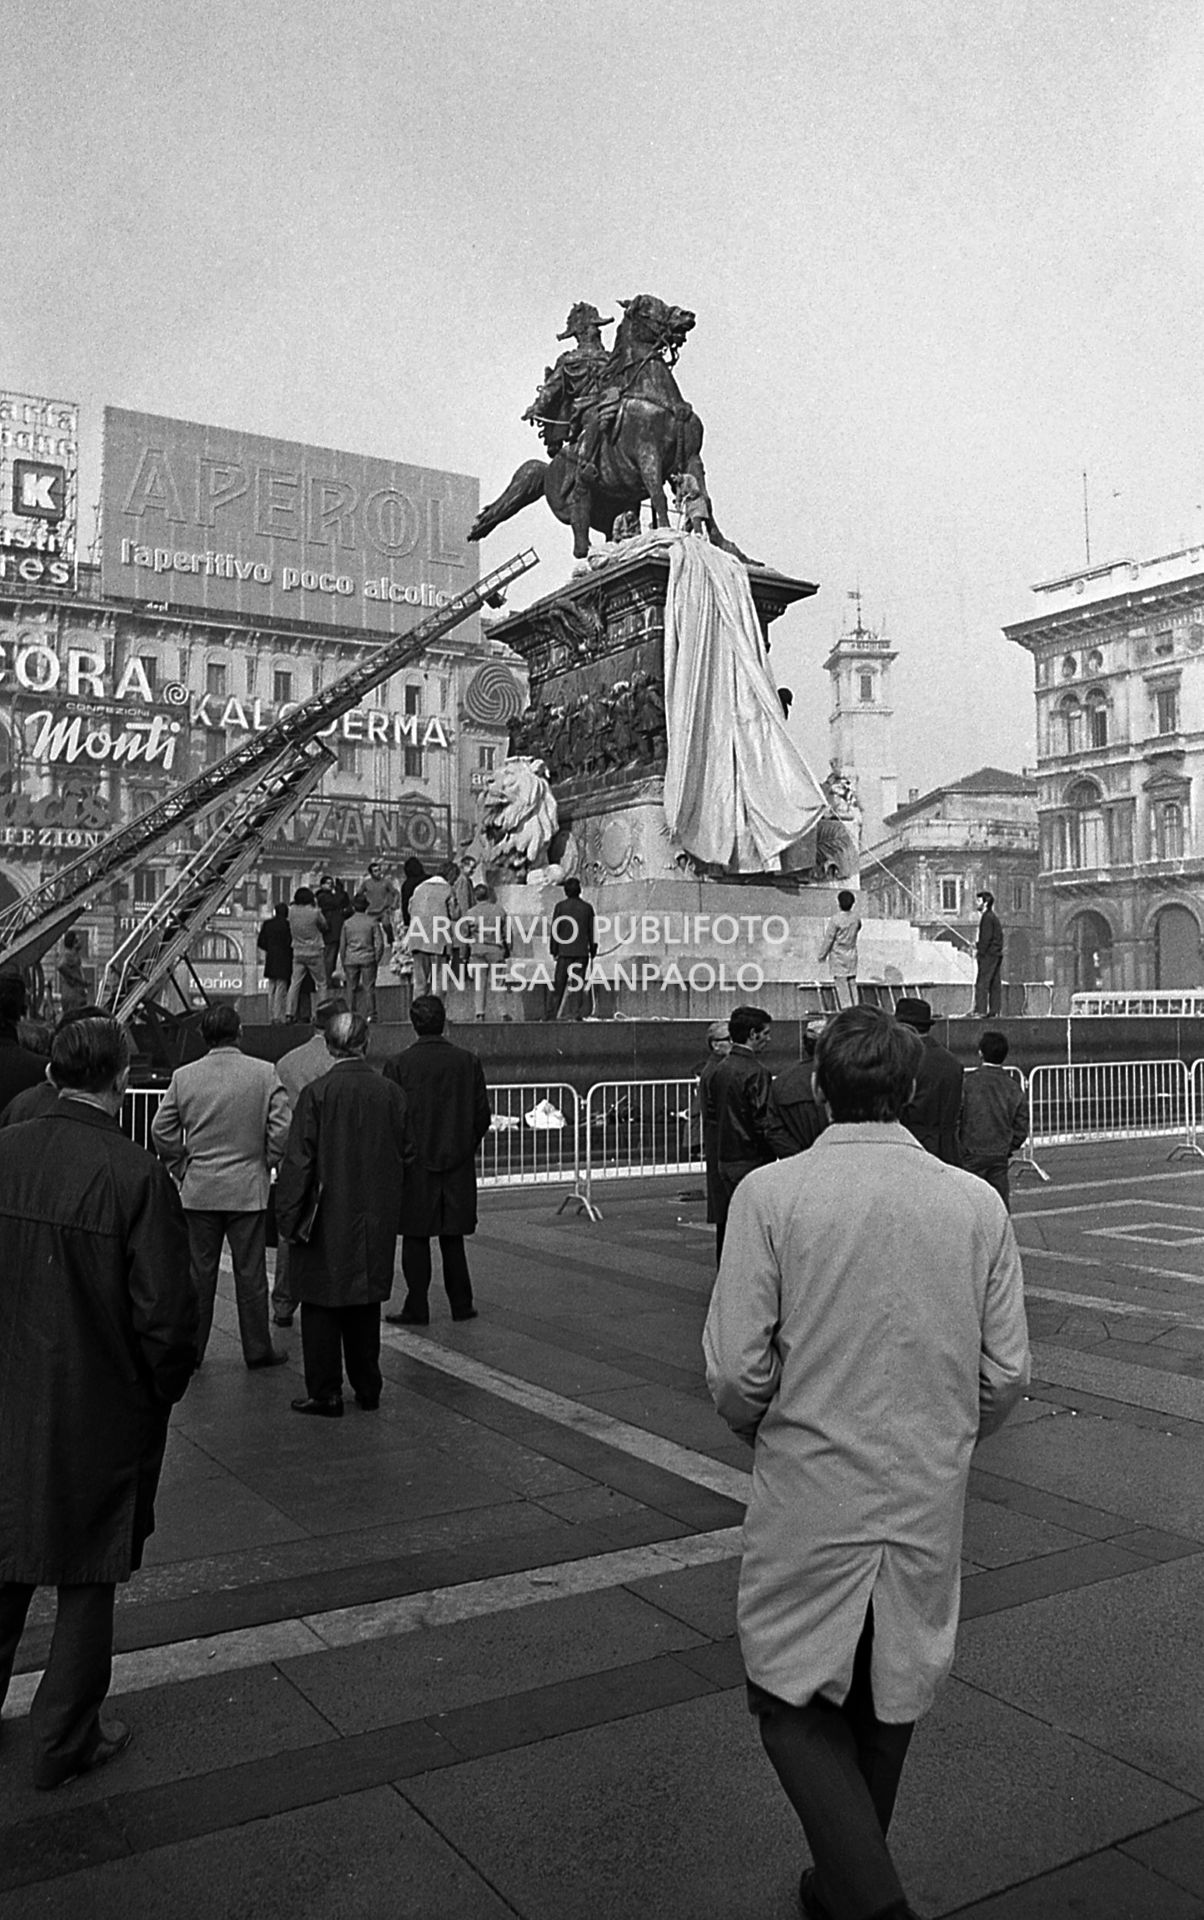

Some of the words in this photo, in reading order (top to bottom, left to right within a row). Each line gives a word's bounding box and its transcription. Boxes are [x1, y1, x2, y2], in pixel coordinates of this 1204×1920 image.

[22, 472, 58, 510] K
[122, 448, 465, 568] APEROL
[121, 538, 273, 584] l'aperitivo
[282, 566, 354, 598] poco
[0, 645, 153, 703] ORA
[66, 702, 150, 717] CONFEZIONI
[24, 710, 181, 770] Monti
[209, 800, 437, 851] NZANO
